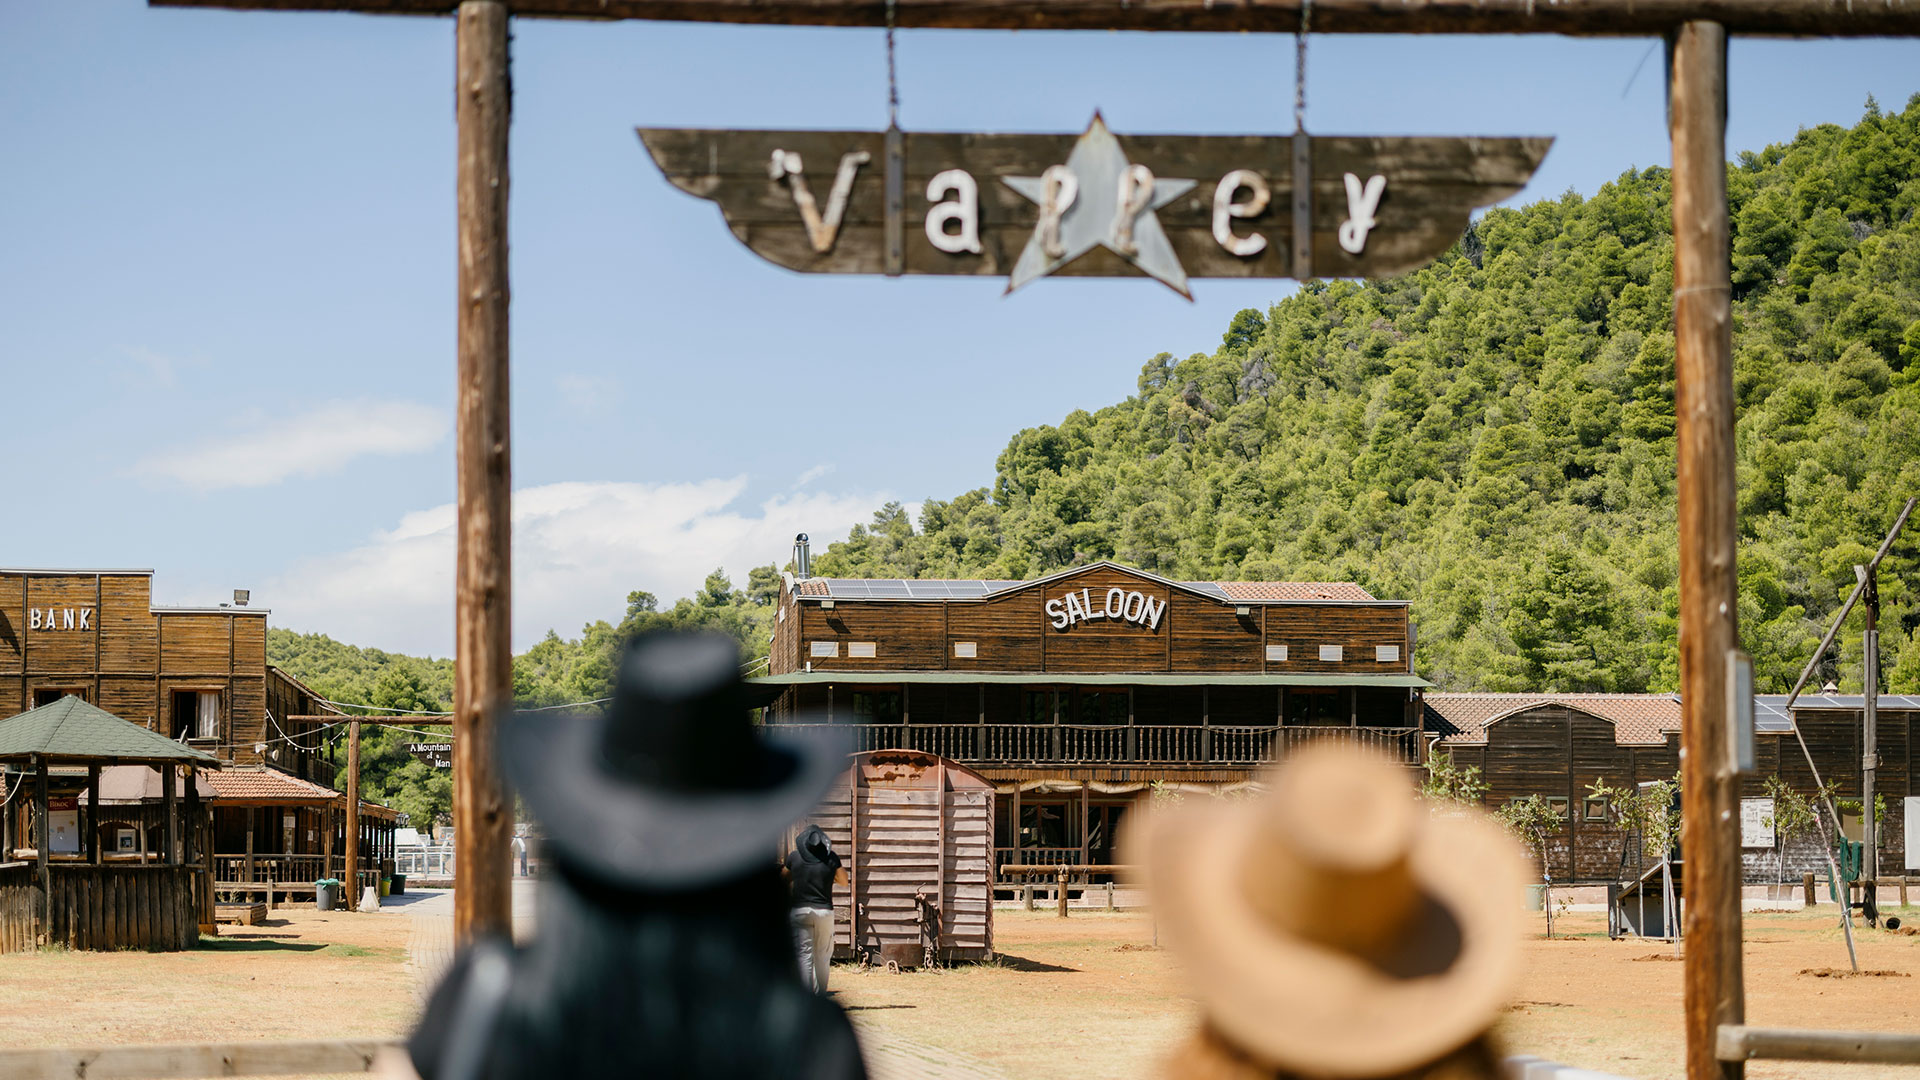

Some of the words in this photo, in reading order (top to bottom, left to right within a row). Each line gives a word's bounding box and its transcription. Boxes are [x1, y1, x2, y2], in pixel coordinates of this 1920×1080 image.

[1045, 587, 1166, 630] SALOON
[30, 608, 92, 629] BANK
[410, 744, 416, 752] A
[417, 743, 451, 752] Mountain
[426, 751, 433, 759] of
[435, 759, 451, 768] Man
